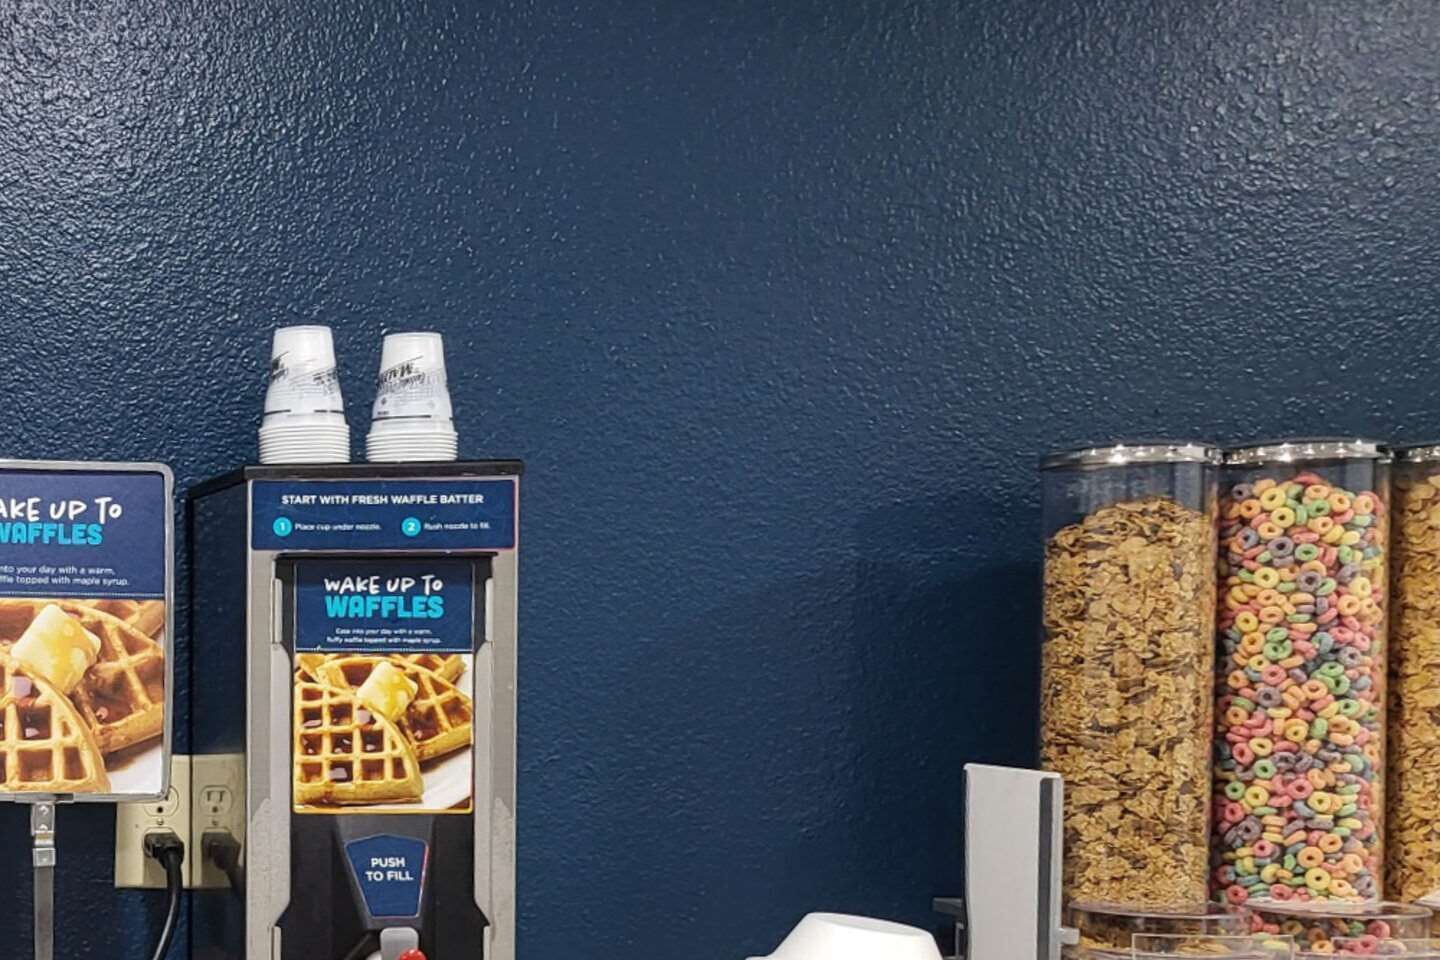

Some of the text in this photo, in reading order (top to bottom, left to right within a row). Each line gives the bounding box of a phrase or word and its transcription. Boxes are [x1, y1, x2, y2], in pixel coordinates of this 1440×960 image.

[281, 493, 485, 505] START WITH FRESH WAFFLE BATTER
[49, 499, 88, 521] UP
[16, 565, 37, 576] your
[39, 564, 57, 576] day
[58, 565, 78, 576] with
[79, 567, 86, 576] a
[16, 575, 50, 586] topped
[51, 575, 71, 586] with
[72, 576, 101, 587] maple
[323, 575, 380, 595] WAKE
[386, 577, 416, 593] UP
[324, 594, 445, 619] WAFFLES
[370, 857, 406, 868] PUSH
[365, 871, 414, 882] TO FILL
